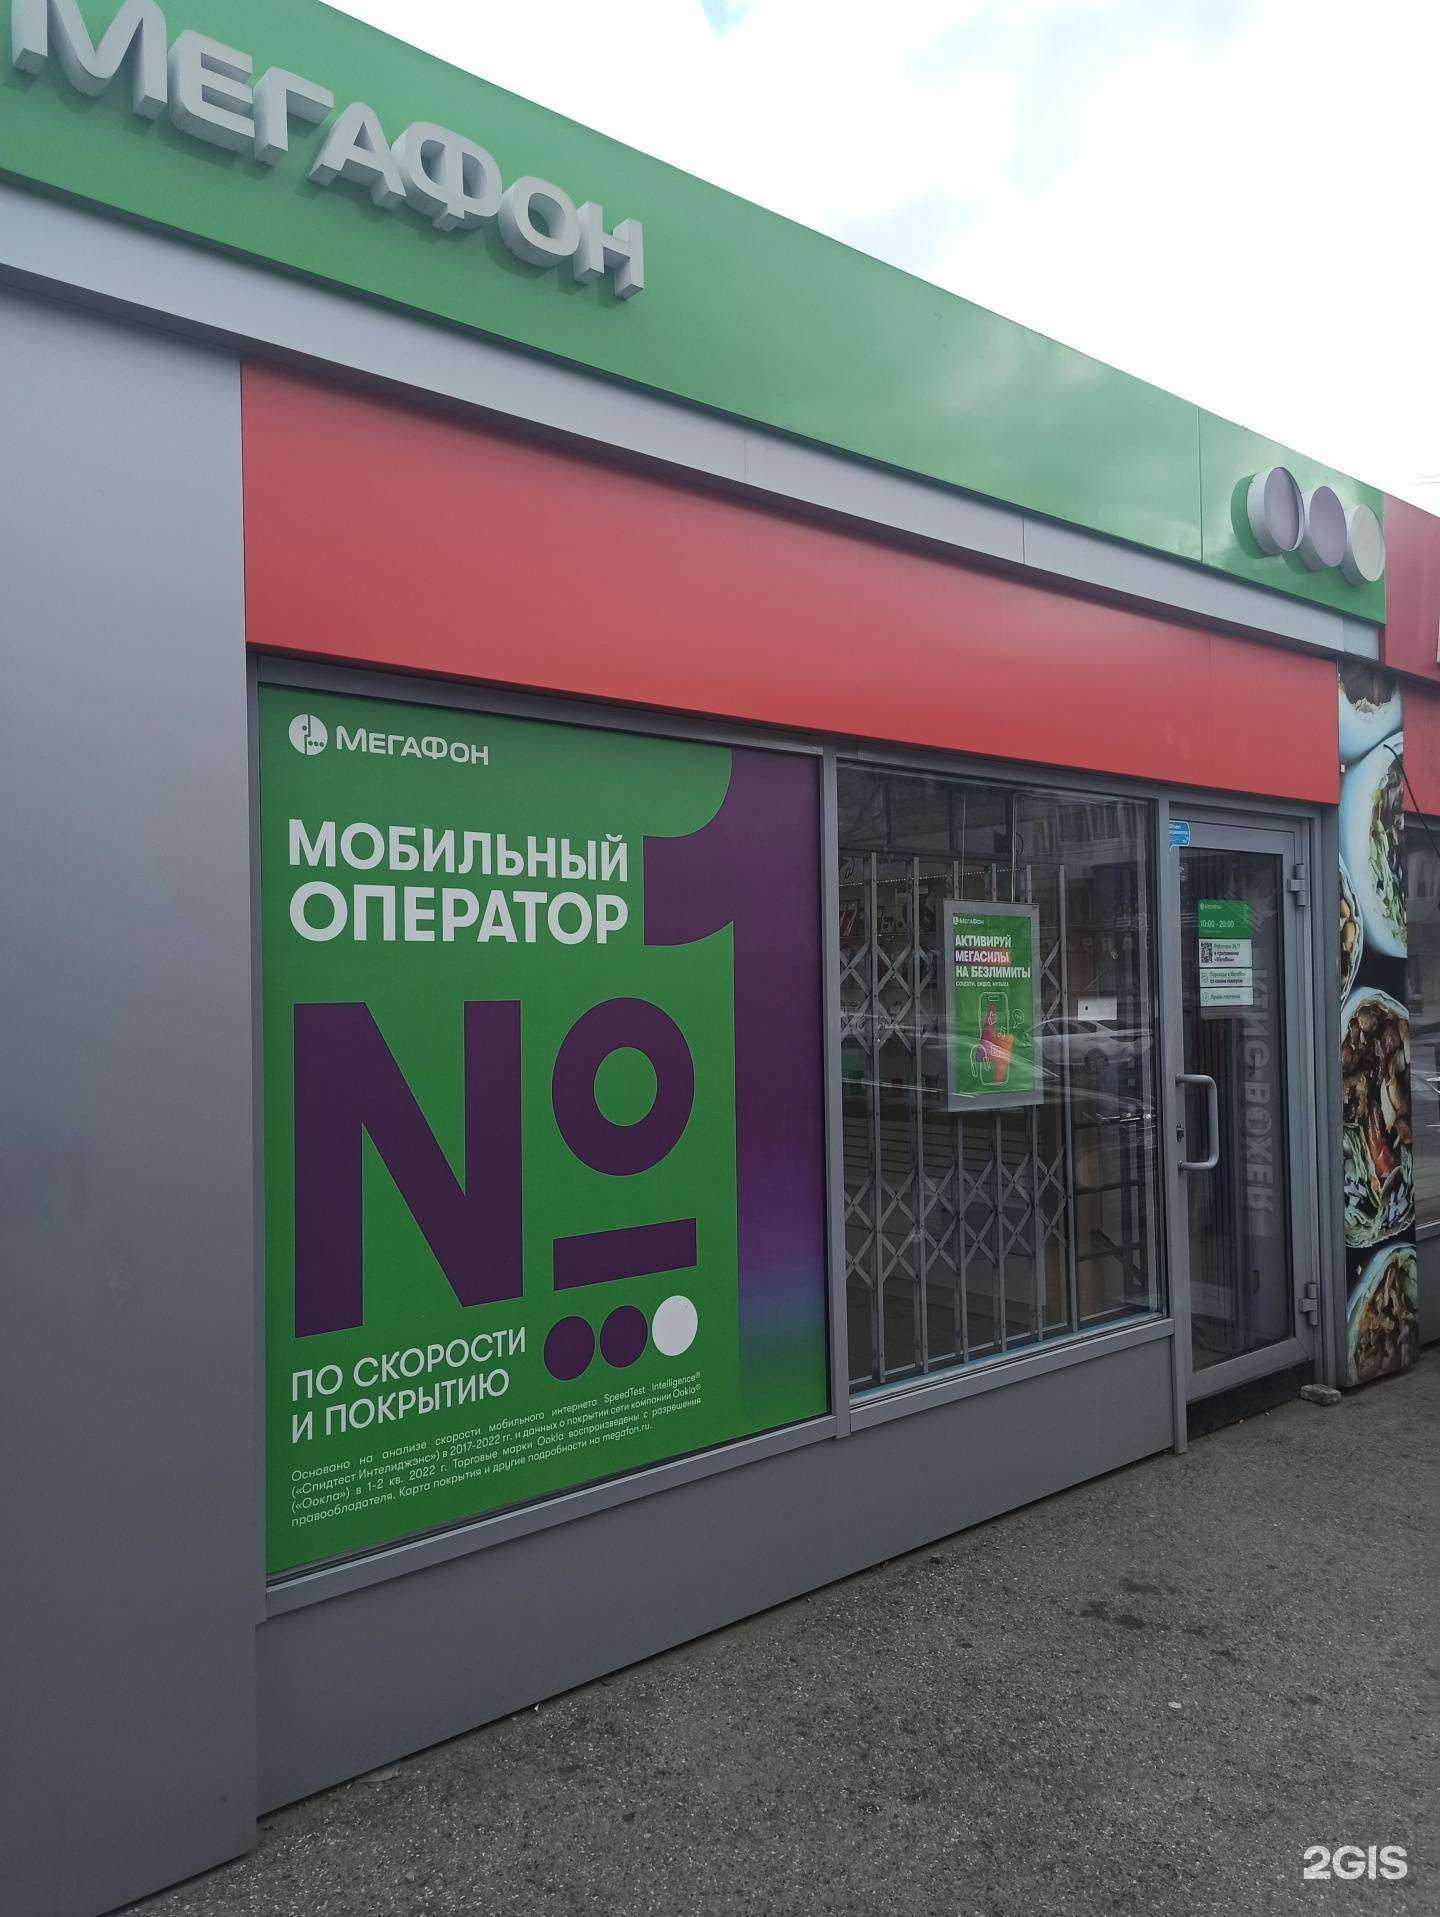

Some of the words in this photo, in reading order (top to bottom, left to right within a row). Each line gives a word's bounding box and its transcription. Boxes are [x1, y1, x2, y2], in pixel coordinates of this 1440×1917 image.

[288, 818, 628, 883] МОБИЛЬНЫЙ
[289, 881, 628, 946] ОПЕРАТОР
[956, 934, 1012, 948] АКТИВИРУЙ
[1200, 919, 1215, 929] 10:00
[1219, 919, 1235, 929] 20:00
[955, 951, 1009, 963] МЕГАСИЛЫ
[956, 966, 969, 978] НА
[972, 966, 1031, 978] БЕЗЛИМИТЫ
[292, 1364, 343, 1401] ПО
[352, 1326, 526, 1388] СКОРОСТИ
[291, 1461, 351, 1483] Основано
[359, 1454, 374, 1465] на
[382, 1441, 428, 1460] анализе
[435, 1428, 481, 1448] скорости
[488, 1411, 545, 1432] мобильного
[551, 1399, 598, 1417] интернета
[603, 1386, 646, 1405] SpeedTest
[292, 1411, 313, 1444] И
[325, 1368, 510, 1436] ПОКРЫТИЮ
[442, 1450, 448, 1458] в
[450, 1434, 500, 1456] 2017-2022
[515, 1431, 521, 1439] и
[523, 1421, 557, 1439] данных
[559, 1420, 565, 1428] о
[567, 1408, 609, 1426] покрытии
[610, 1404, 629, 1415] сети
[631, 1394, 671, 1410] компании
[291, 1487, 350, 1514] («Оокла»)
[356, 1487, 362, 1495] в
[367, 1479, 384, 1493] 1-2
[389, 1475, 403, 1487] кв.
[409, 1466, 436, 1481] 2022
[440, 1464, 447, 1472] г.
[452, 1450, 498, 1469] Торговые
[502, 1441, 533, 1455] марки
[537, 1432, 564, 1446] Ookla
[568, 1413, 640, 1438] воспроизведены
[652, 1397, 702, 1418] разрешения
[291, 1492, 396, 1528] правообладателя.
[399, 1480, 431, 1498] Карта
[433, 1468, 482, 1489] покрытия
[484, 1466, 490, 1474] и
[493, 1455, 526, 1474] другие
[528, 1441, 588, 1462] подробности
[589, 1436, 600, 1446] на
